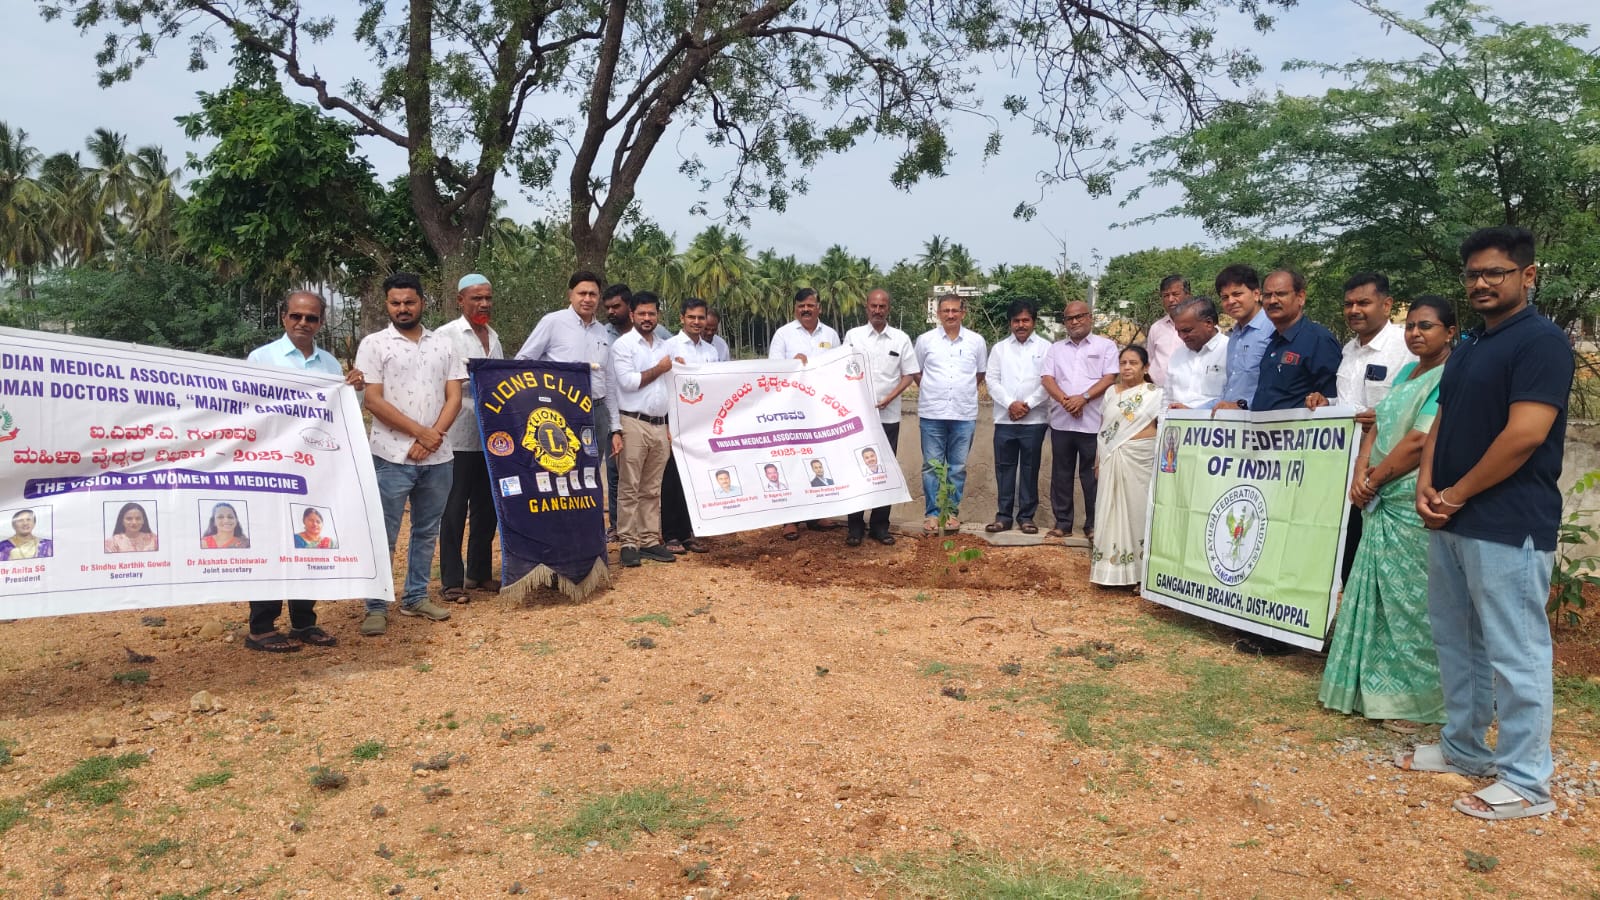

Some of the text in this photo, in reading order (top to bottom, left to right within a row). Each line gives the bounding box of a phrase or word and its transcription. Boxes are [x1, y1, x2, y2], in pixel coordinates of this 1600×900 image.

[50, 358, 125, 380] MEDICAL
[130, 367, 228, 391] ASSOCIATION
[232, 380, 312, 401] GANGAVATHI
[316, 392, 327, 401] &
[0, 379, 44, 397] MAN
[50, 382, 129, 403] DOCTORS
[134, 389, 181, 410] WING,
[255, 404, 334, 423] GANGAVATHI
[484, 371, 592, 414] LIONS CLUB
[531, 410, 563, 426] LIONS
[756, 410, 806, 423] ಗಂಗಾವತಿ
[187, 427, 256, 442] ಗಂಗಾವತಿ
[545, 428, 563, 453] L
[716, 422, 855, 448] INDIAN MEDICAL ASSOCIATION GANGAVATHI
[1183, 427, 1346, 451] AYUSH FEDERATION
[13, 445, 81, 464] ಮಹಿಳಾ
[155, 448, 205, 462] ವಿಭಾಗ
[233, 449, 315, 467] 2025-26
[770, 447, 813, 457] 2025-26
[1207, 456, 1305, 487] OF INDIA (R)
[35, 472, 299, 494] THE VISION OF WOMEN IN MEDICINE
[529, 495, 597, 513] GANGAVATI
[1207, 512, 1217, 551] AYUSH
[1216, 489, 1259, 513] FEDERATION
[1257, 501, 1264, 514] OF
[80, 560, 171, 572] Dr Sindhu Karthik Gowda
[110, 571, 143, 580] Secretary
[222, 566, 252, 574] secretary
[5, 574, 41, 584] President
[1206, 586, 1244, 614] BRANCH,
[1246, 597, 1310, 628] DIST-KOPPAL
